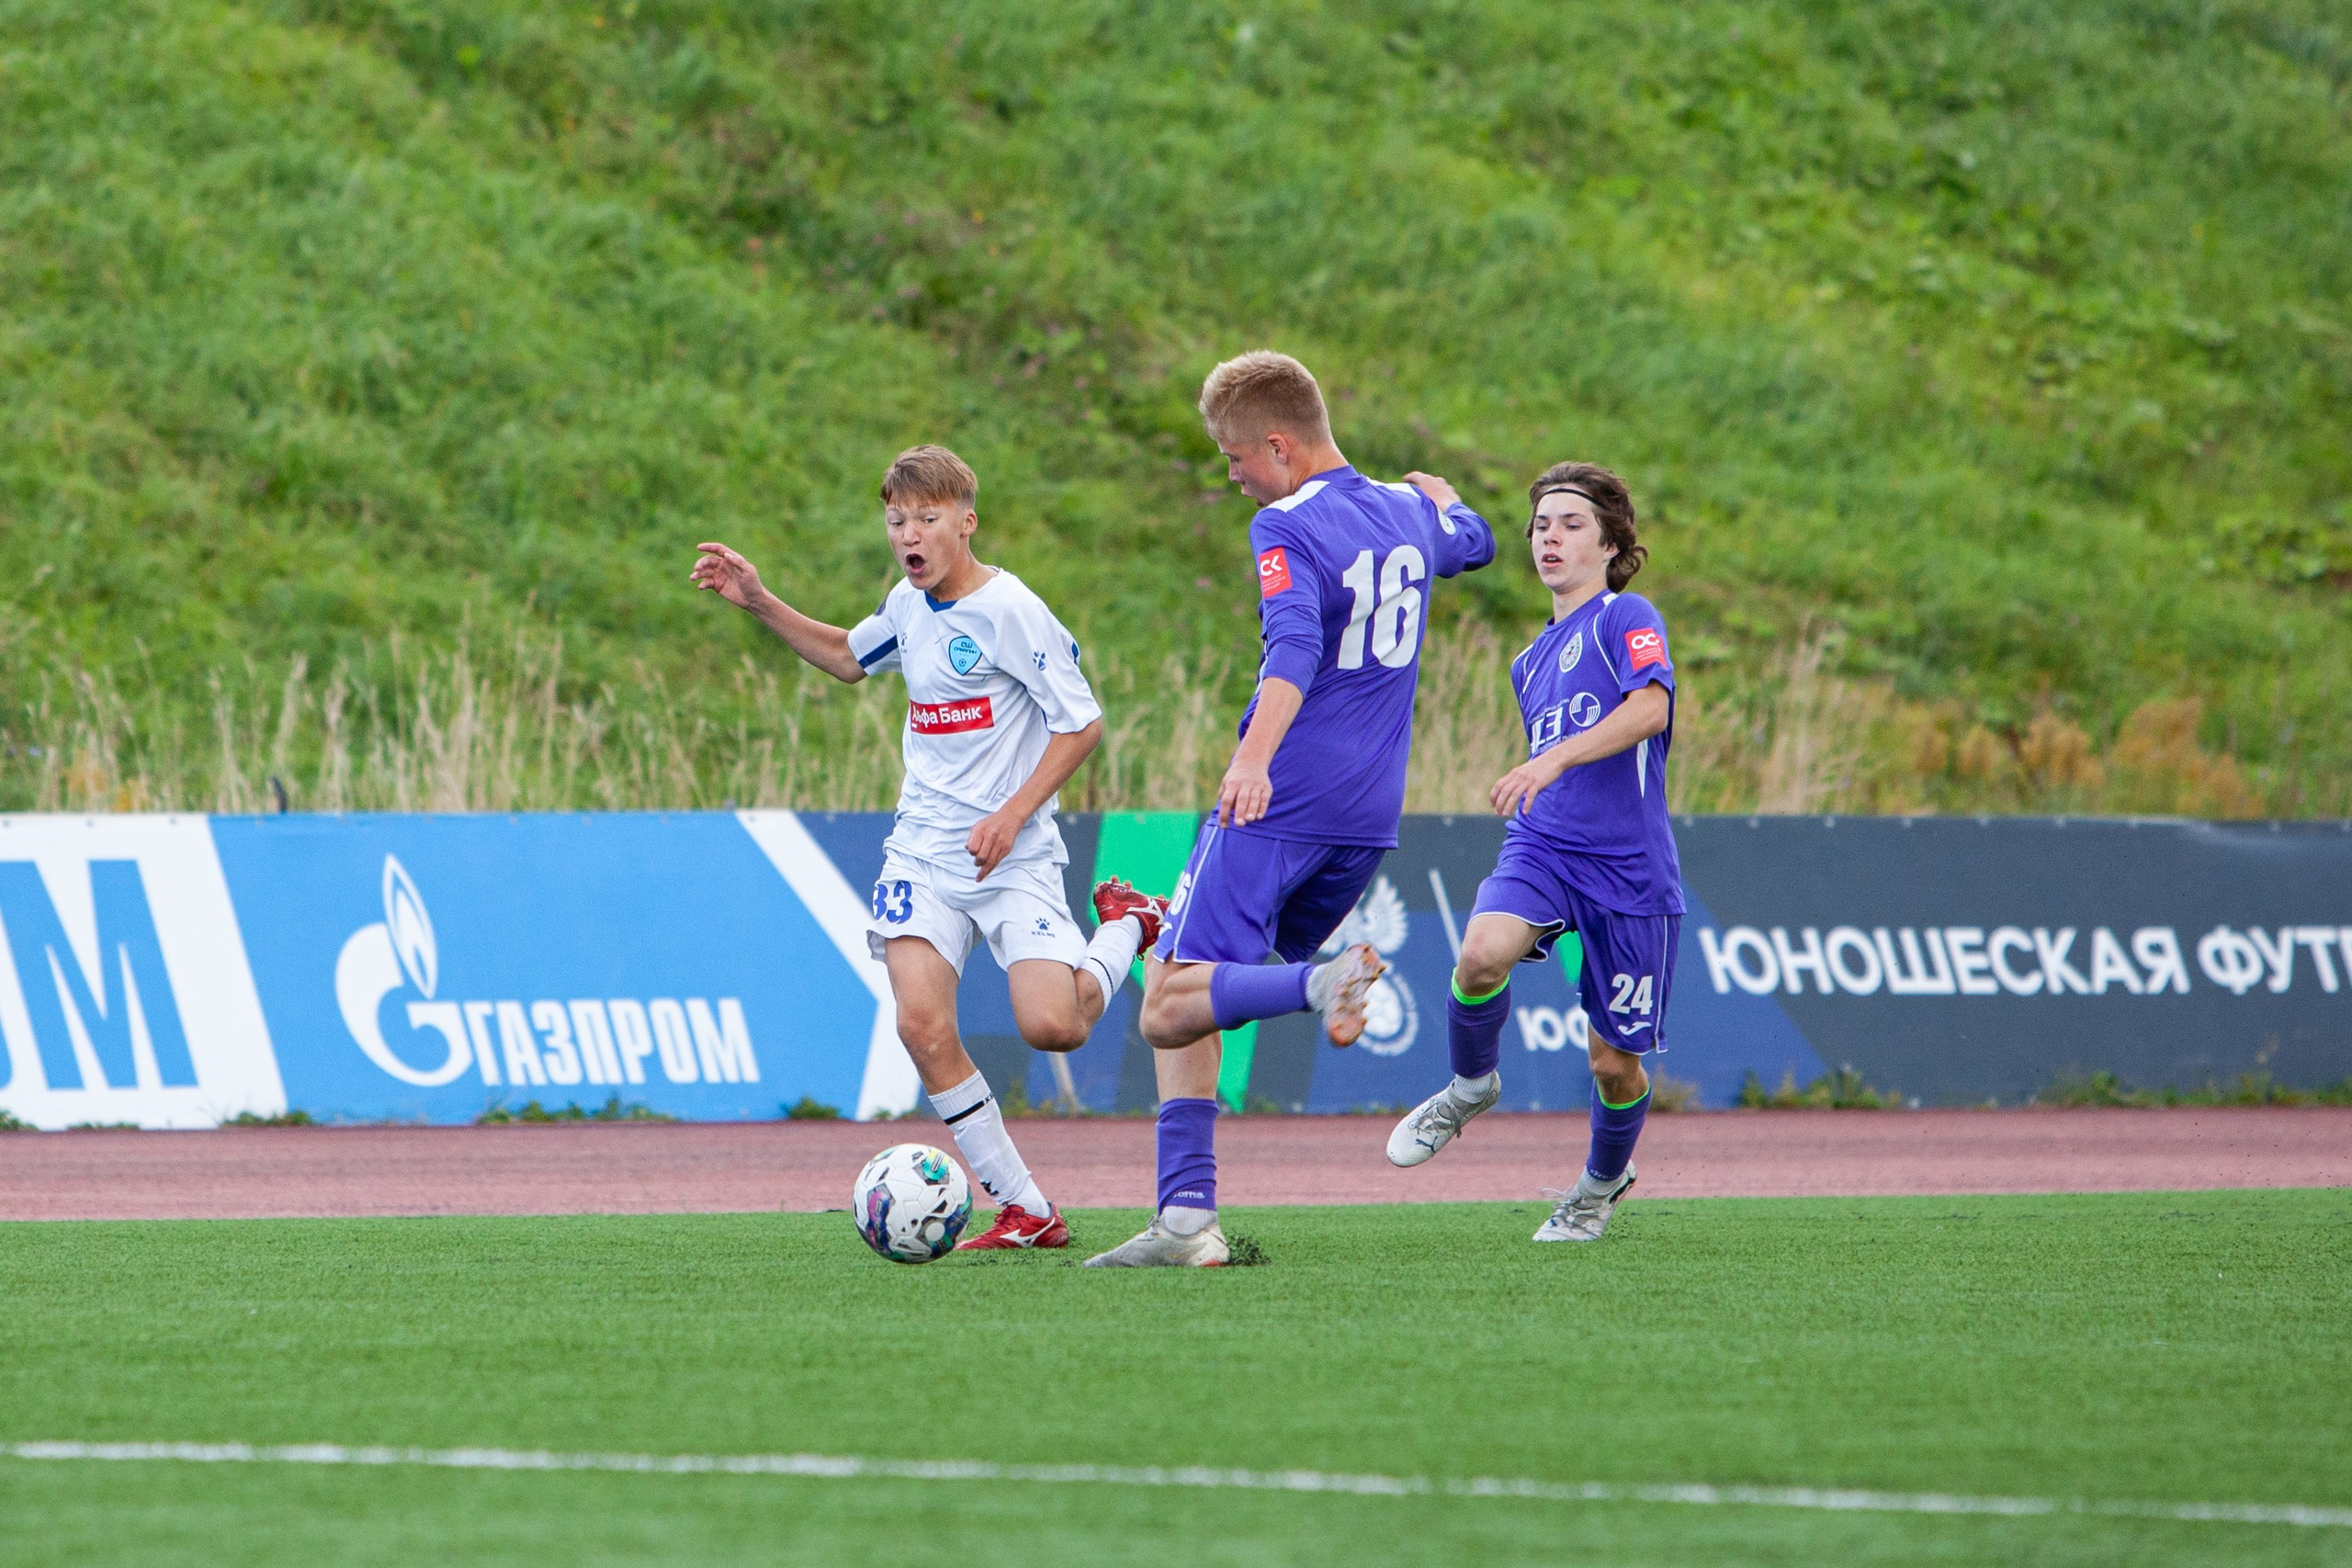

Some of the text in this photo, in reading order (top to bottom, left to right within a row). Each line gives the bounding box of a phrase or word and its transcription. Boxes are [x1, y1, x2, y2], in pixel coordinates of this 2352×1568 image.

[1338, 545, 1425, 670] 16
[938, 705, 983, 724] Банк
[1168, 873, 1192, 916] 6
[0, 858, 200, 1089] М
[1698, 925, 2192, 996] ЮНОШЕСКАЯ
[1609, 973, 1654, 1016] 24
[462, 998, 761, 1087] ГАЗПРОМ
[1173, 1190, 1205, 1200] oma
